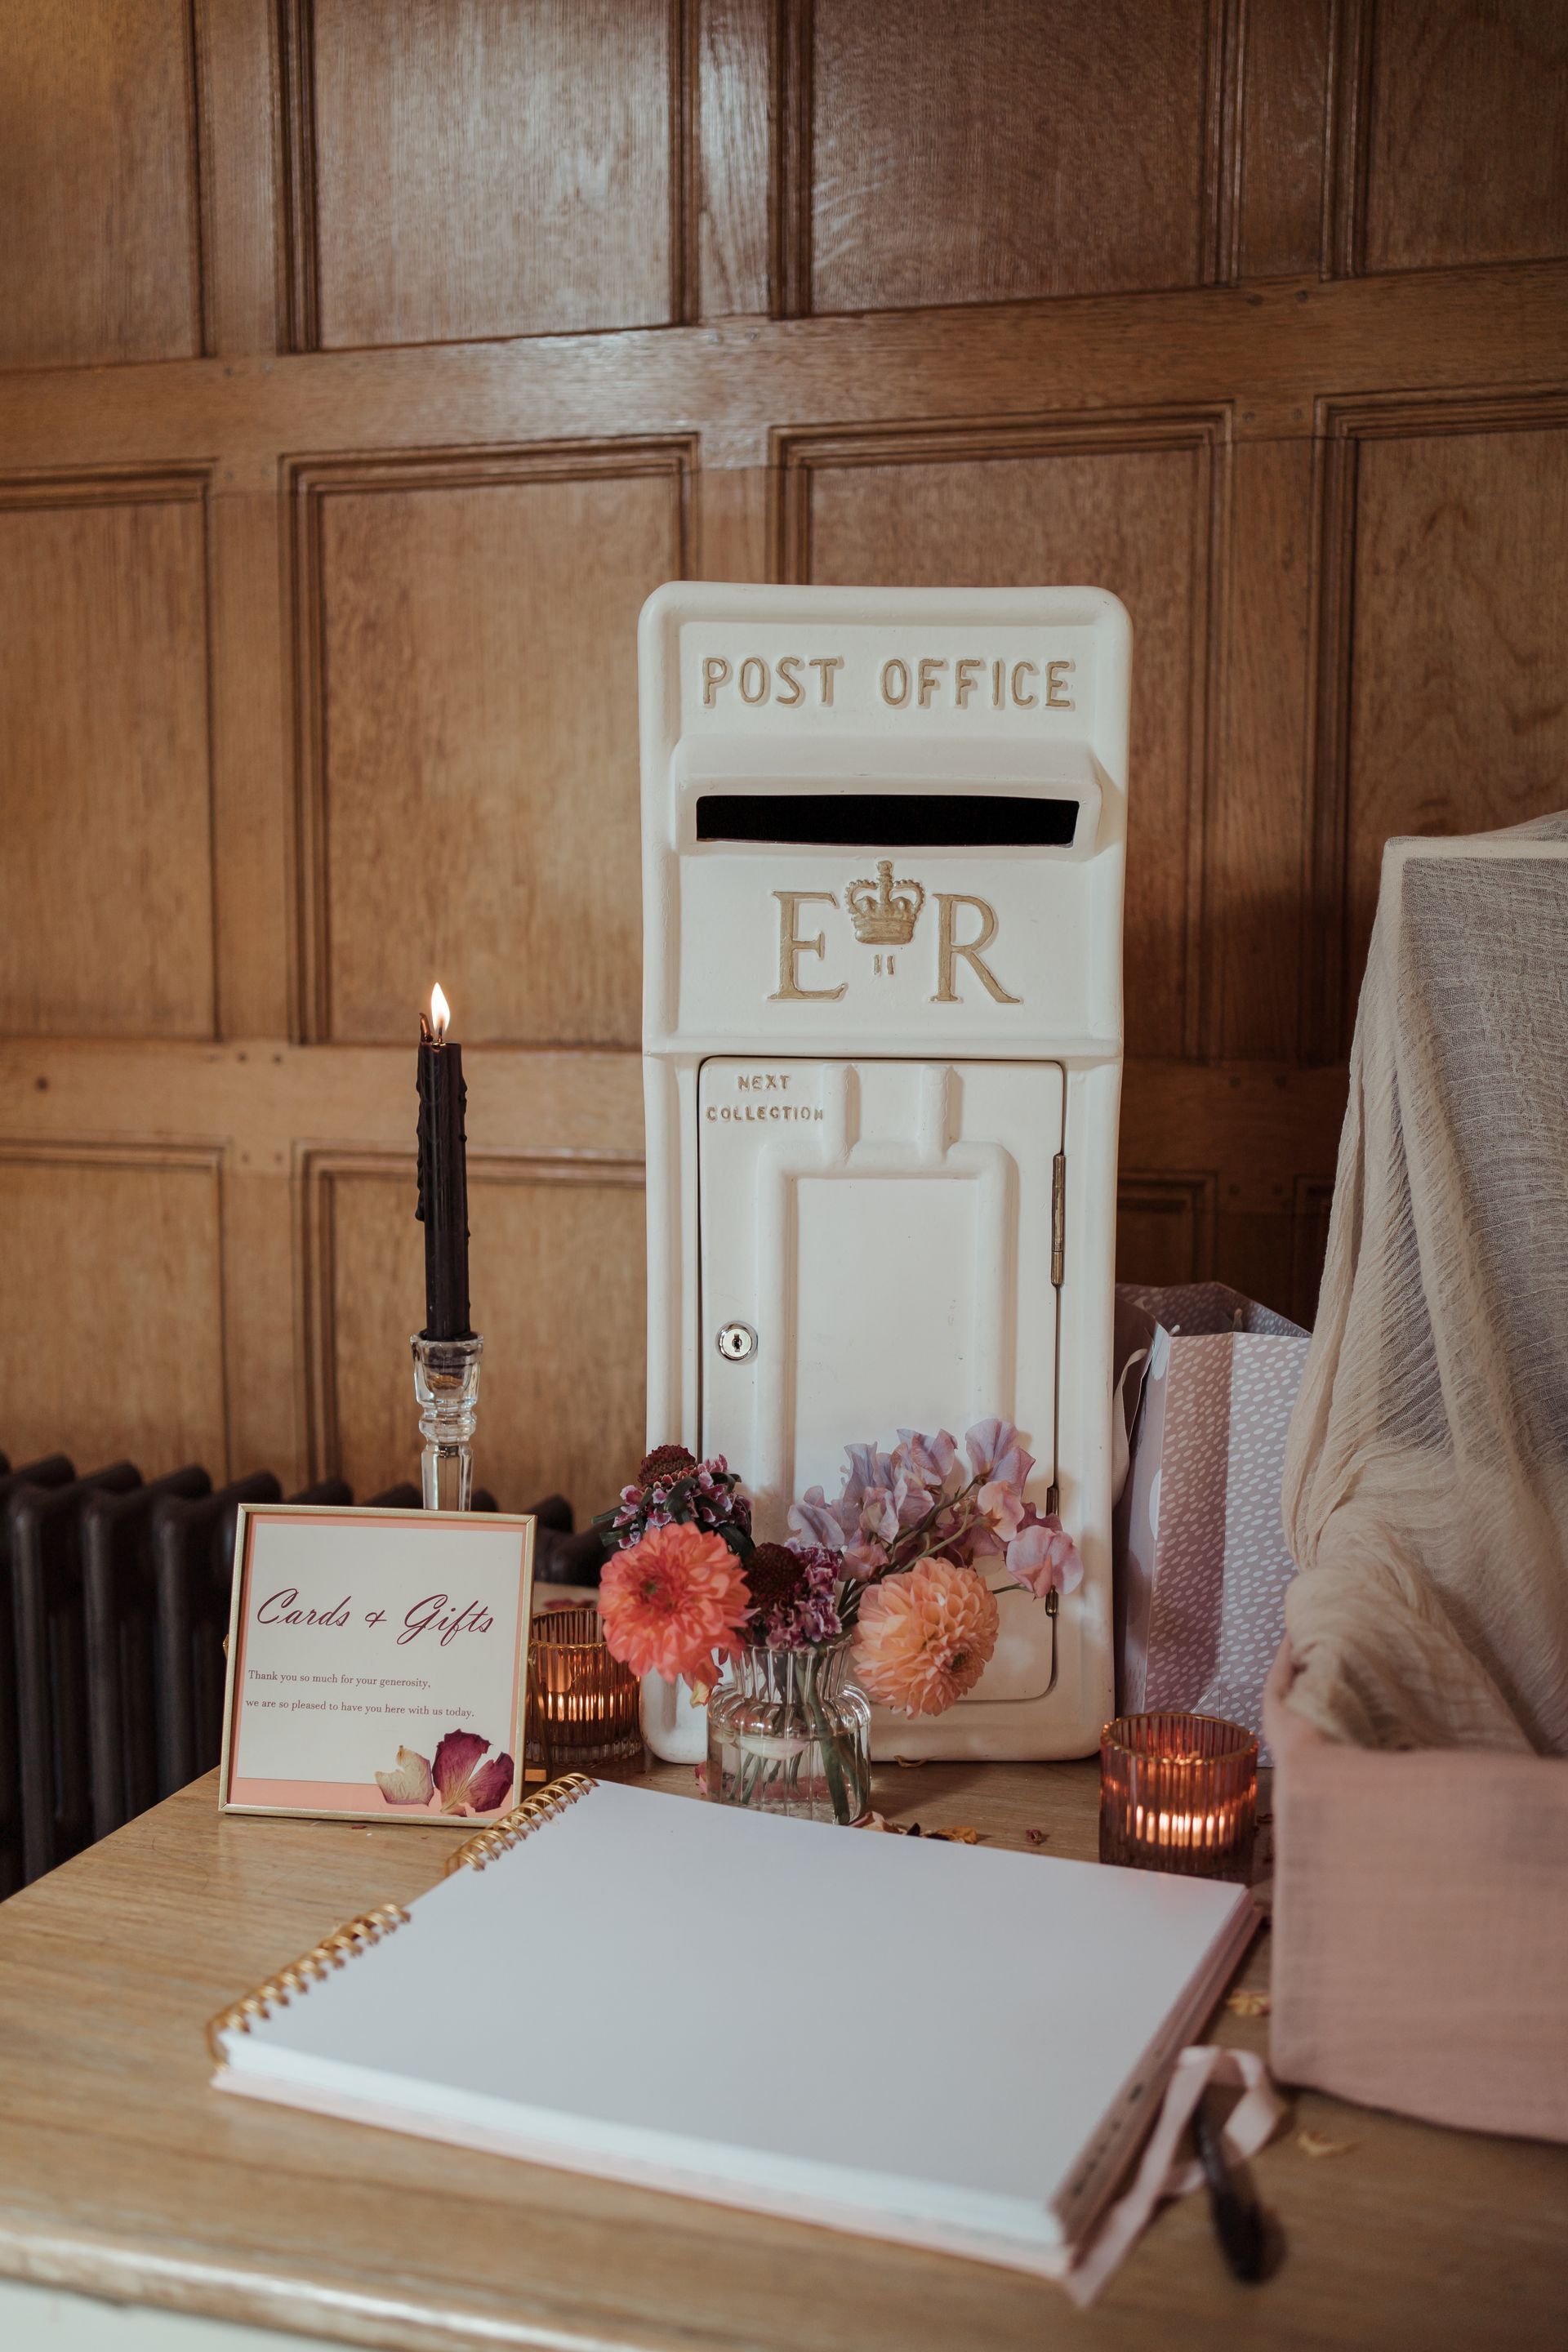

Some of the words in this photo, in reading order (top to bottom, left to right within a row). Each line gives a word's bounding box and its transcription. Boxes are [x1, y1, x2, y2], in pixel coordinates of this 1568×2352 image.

[702, 657, 838, 706] POST
[880, 659, 1076, 707] OFFICE
[737, 1075, 791, 1090] NEXT
[706, 1106, 823, 1121] COLLECTION
[256, 1588, 352, 1627] Cards
[396, 1593, 495, 1647] Gifts
[248, 1669, 278, 1681] Thank
[280, 1673, 297, 1683] you
[312, 1674, 338, 1683] much
[340, 1674, 354, 1684] for
[355, 1677, 378, 1687] your
[291, 1699, 327, 1711] pleased
[329, 1703, 339, 1711] to
[341, 1702, 363, 1712] have
[365, 1705, 382, 1715] you
[385, 1704, 406, 1714] here
[408, 1705, 430, 1715] with
[445, 1707, 474, 1720] today.
